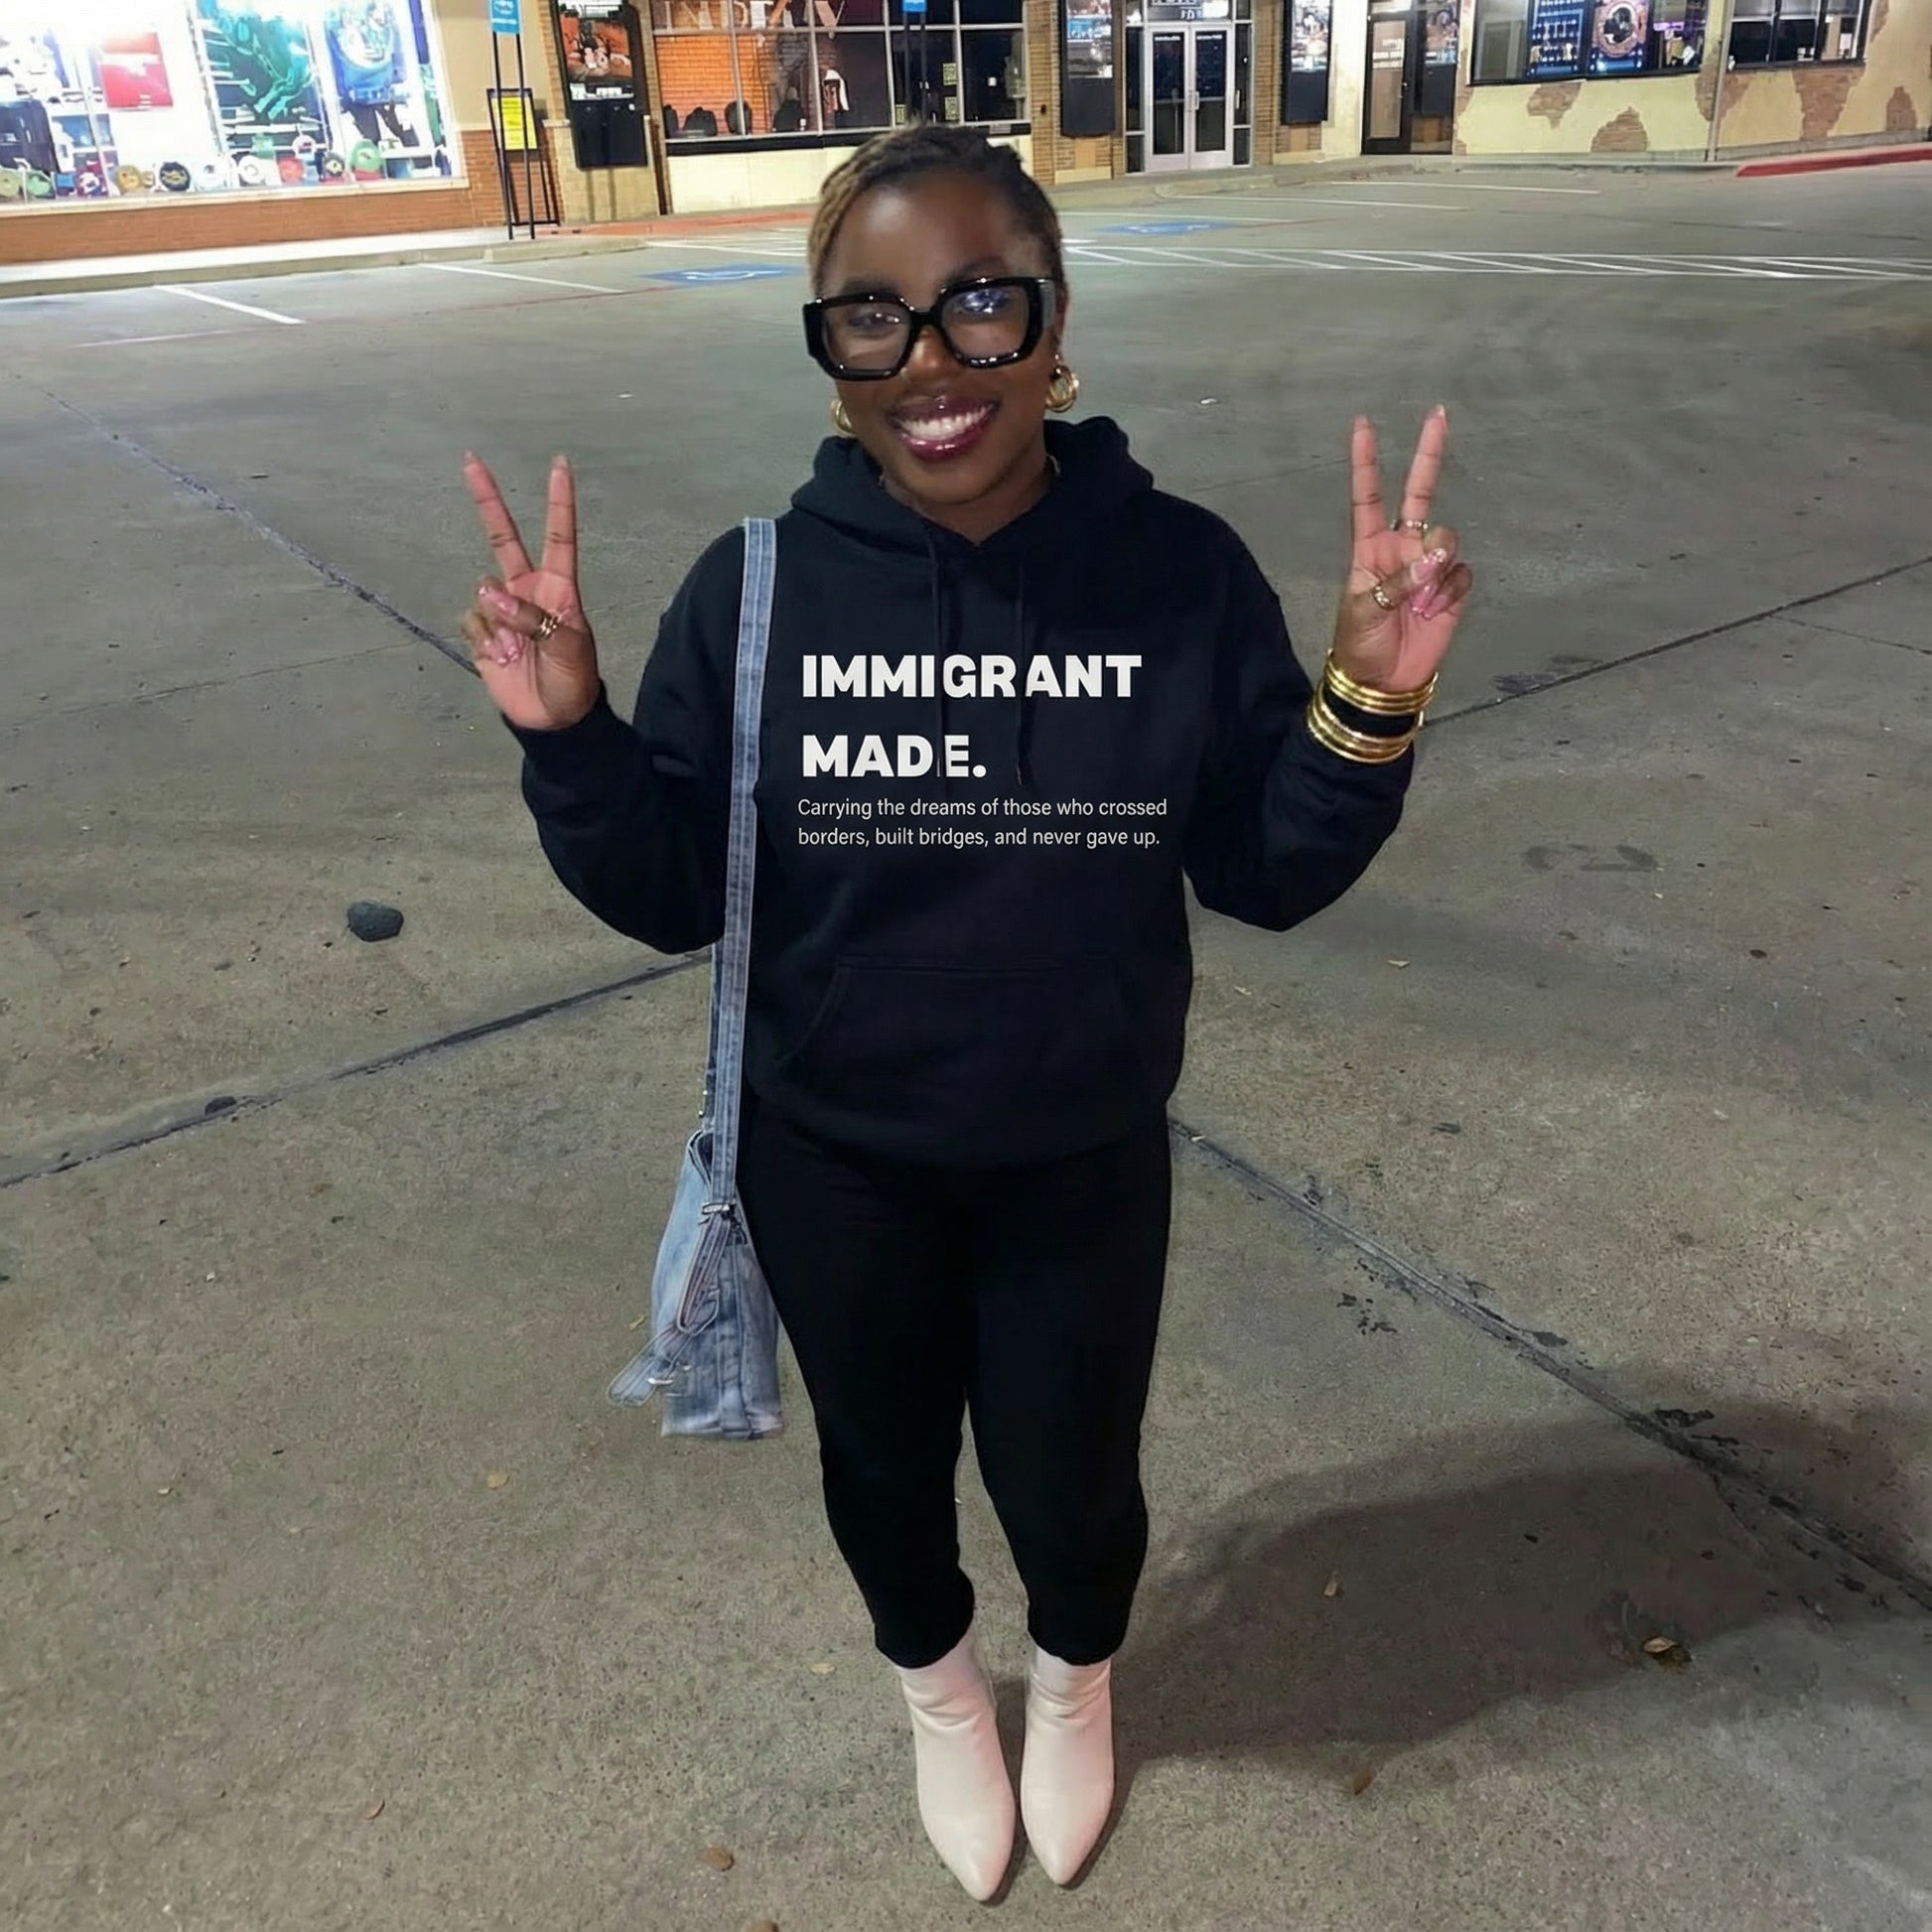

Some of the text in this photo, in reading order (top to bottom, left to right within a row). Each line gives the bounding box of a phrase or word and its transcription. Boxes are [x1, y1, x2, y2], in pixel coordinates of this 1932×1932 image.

[802, 654, 1142, 698] IMMIGRANT
[802, 735, 987, 777] MADE.
[797, 798, 1167, 820] Carrying the dreams of those who crossed
[798, 827, 1161, 850] borders, built bridges, and never gave up.
